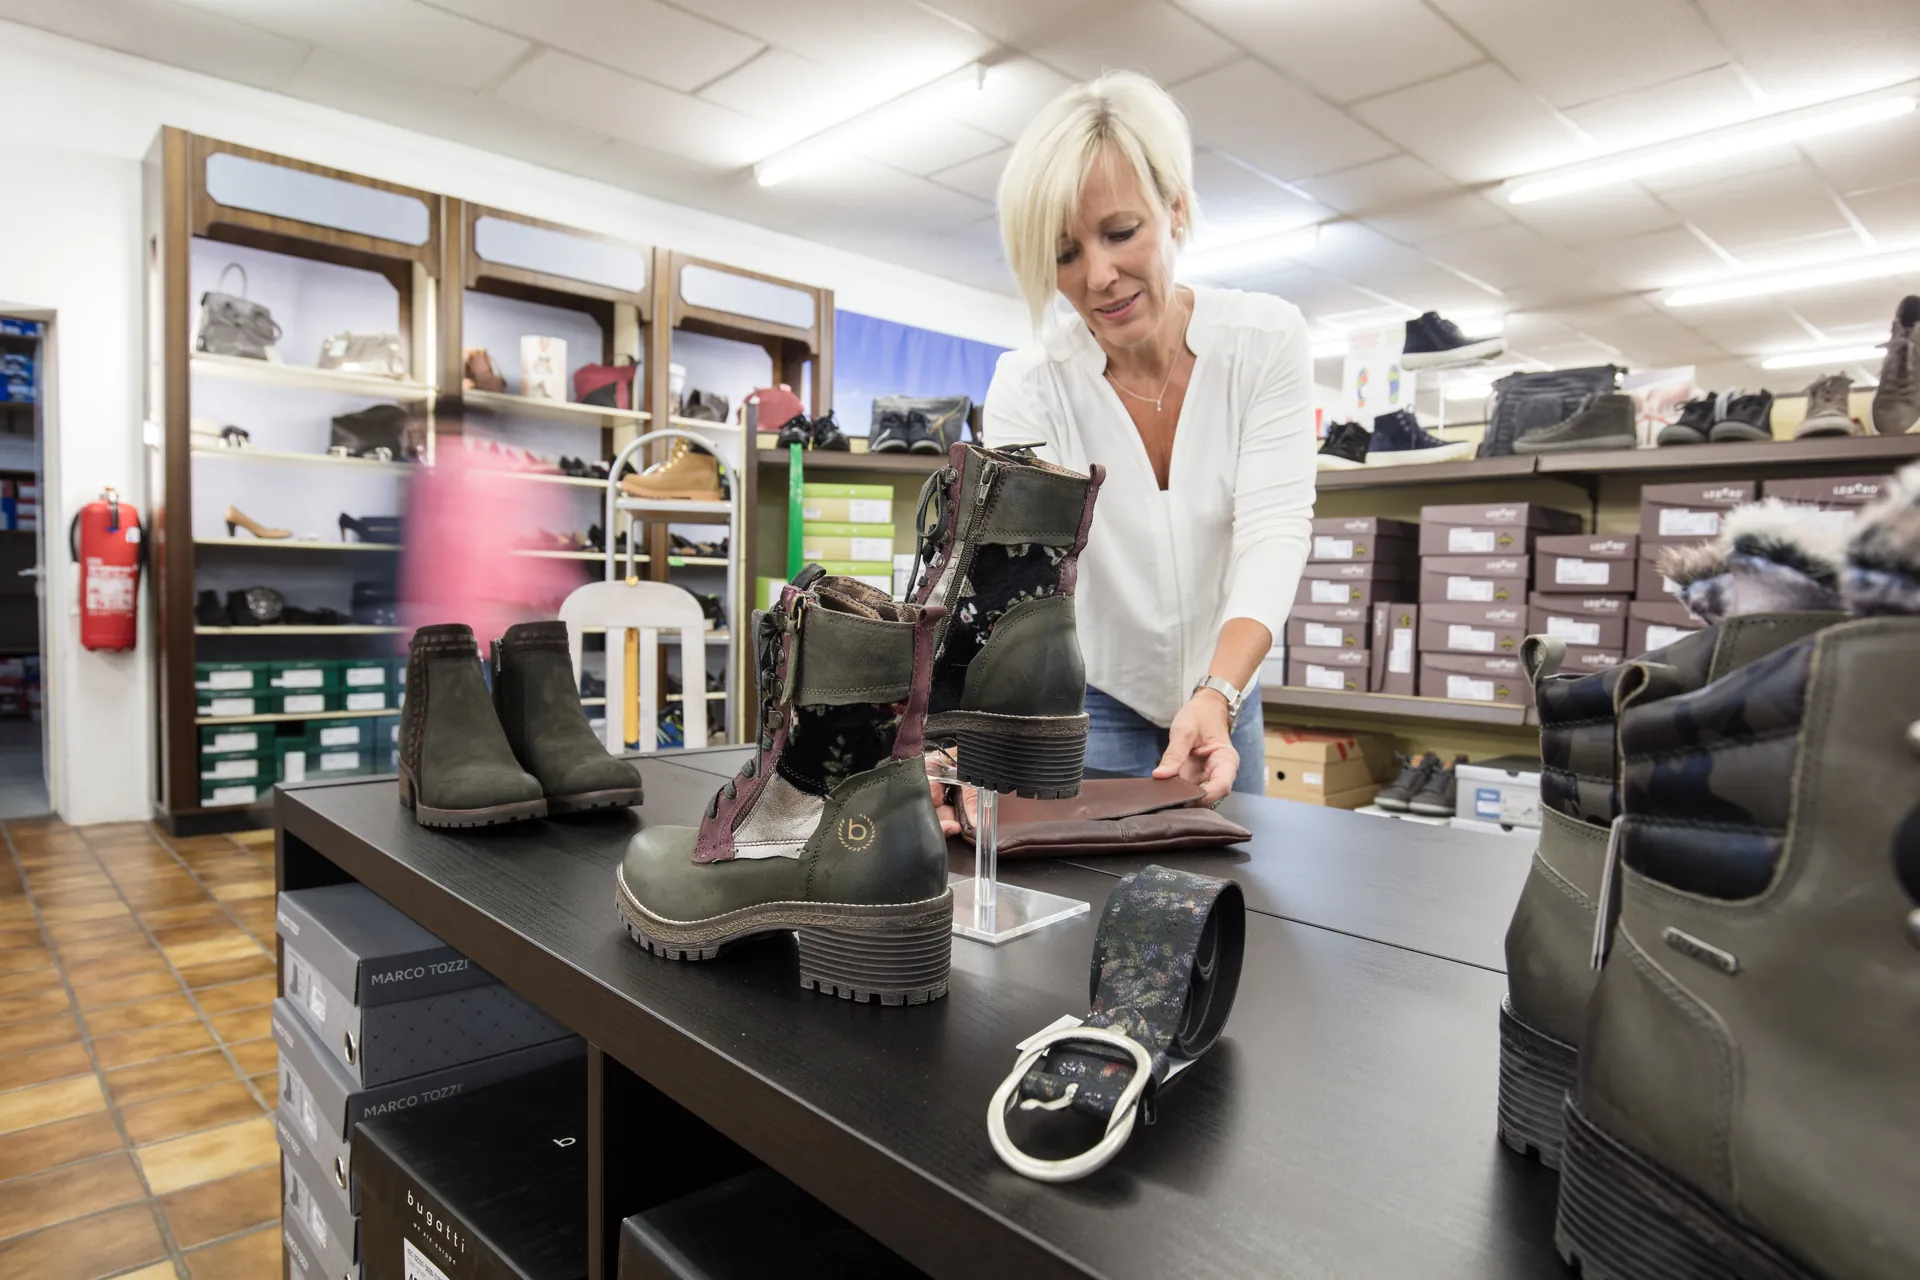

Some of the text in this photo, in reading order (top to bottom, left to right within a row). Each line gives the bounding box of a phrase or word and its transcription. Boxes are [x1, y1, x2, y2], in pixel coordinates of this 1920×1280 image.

[371, 959, 469, 986] MARCO TOZZI
[364, 1083, 462, 1118] MARCO TOZZI
[407, 1190, 465, 1253] bugatti
